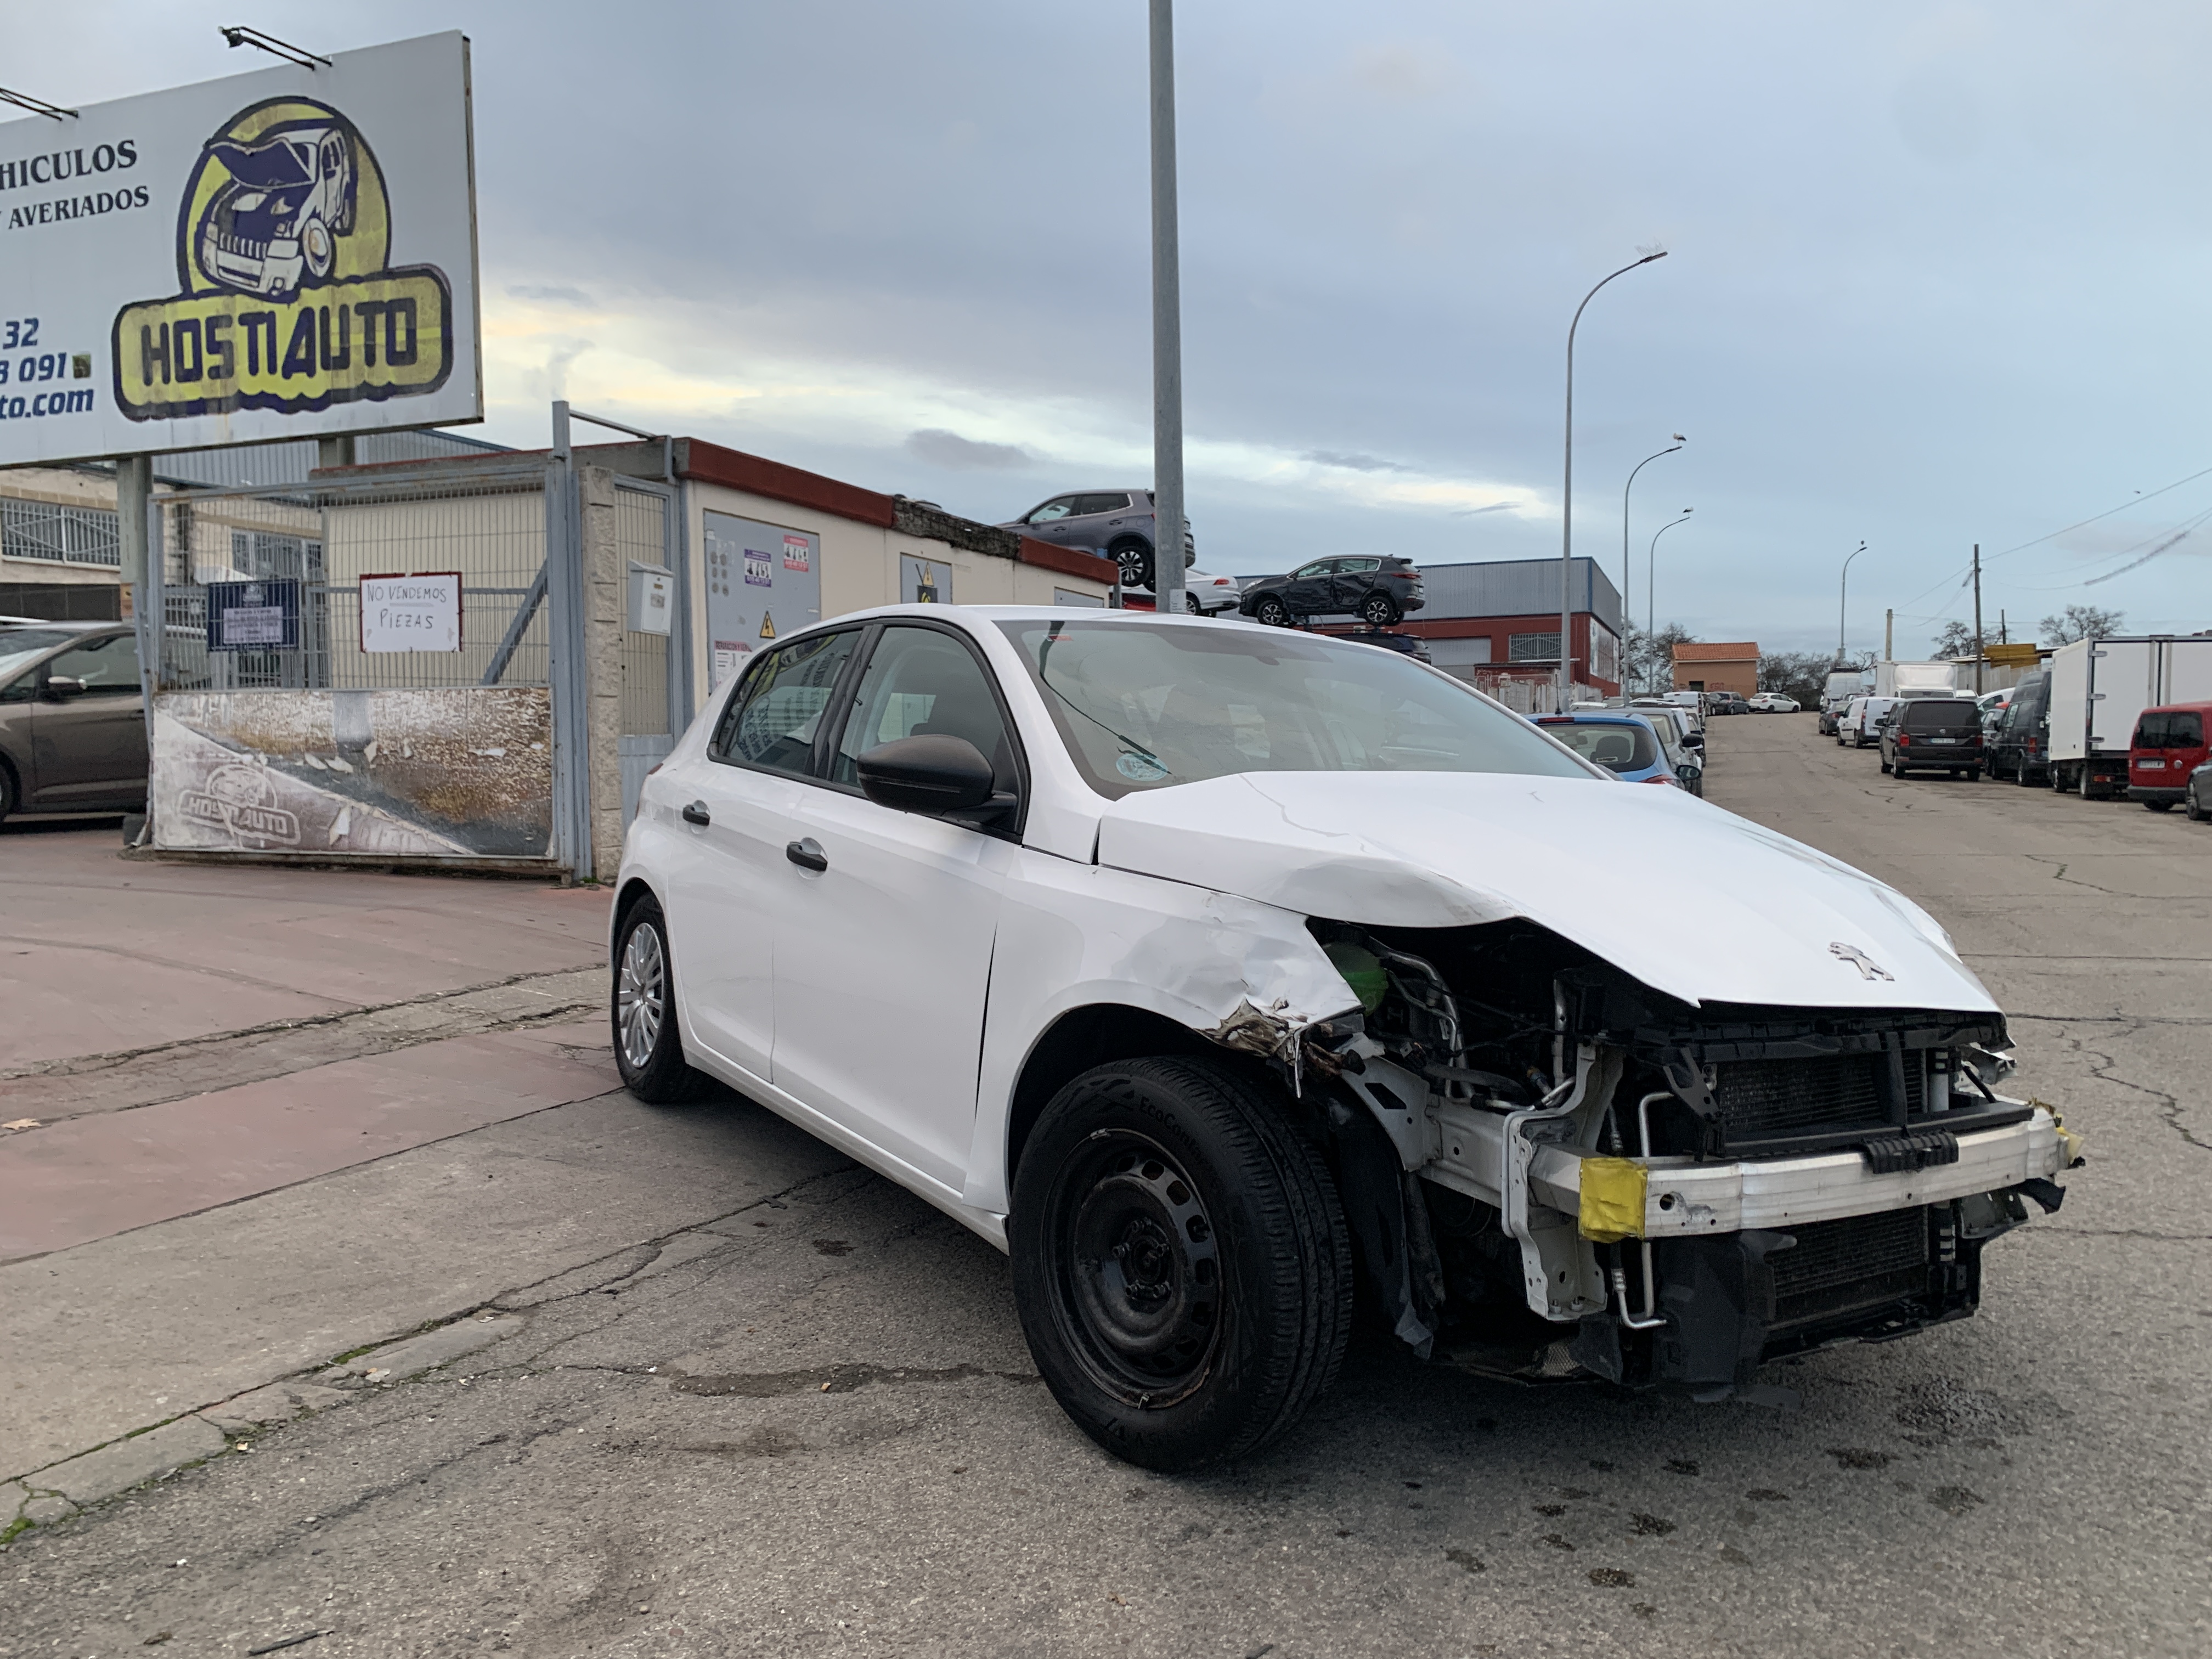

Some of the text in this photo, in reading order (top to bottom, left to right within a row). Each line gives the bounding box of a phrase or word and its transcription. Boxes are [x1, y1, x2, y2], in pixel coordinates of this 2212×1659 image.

[0, 139, 137, 190] HICULOS
[8, 185, 149, 229] AVERIADOS
[3, 317, 39, 349] 32
[141, 297, 417, 386] HOSTIAUTO
[19, 352, 67, 382] 091
[367, 584, 447, 603] NO VENDEMOS
[380, 608, 433, 629] PIEZAS
